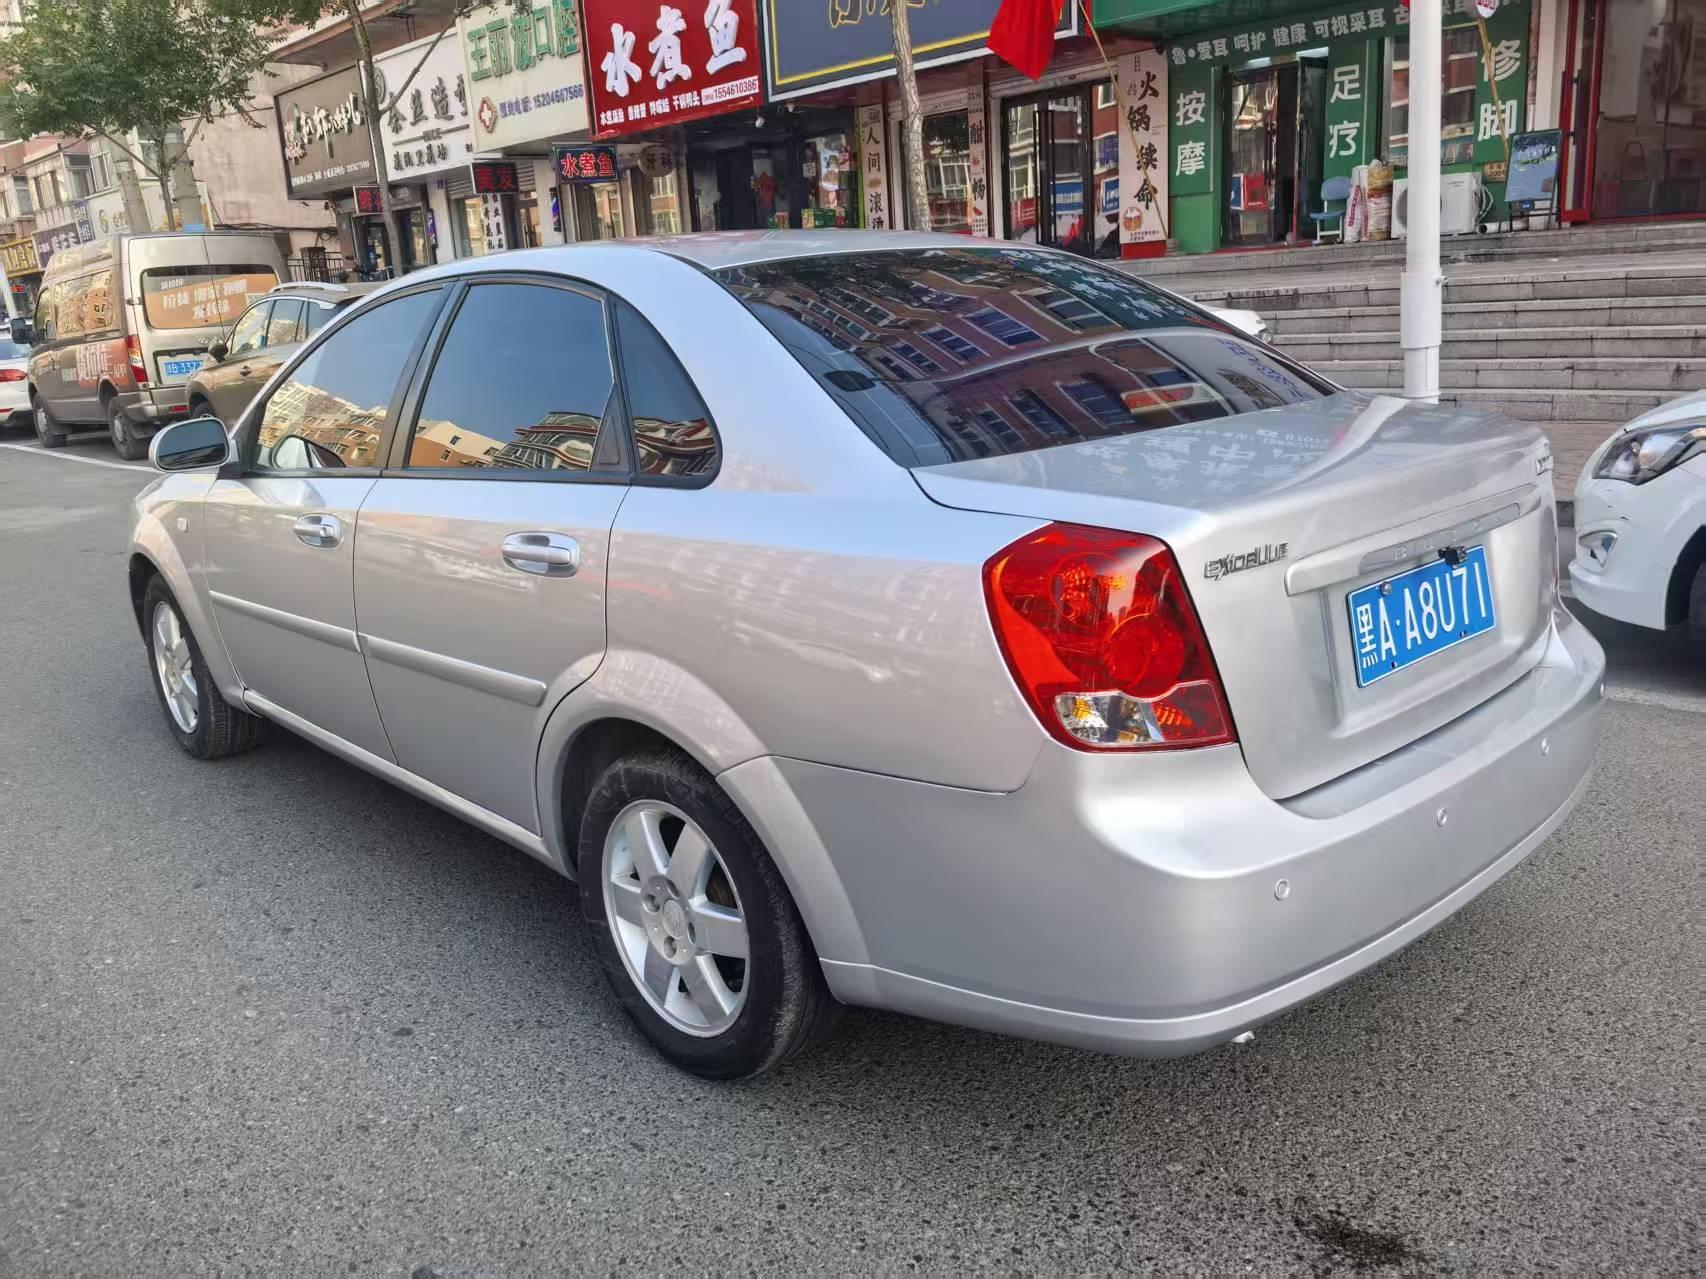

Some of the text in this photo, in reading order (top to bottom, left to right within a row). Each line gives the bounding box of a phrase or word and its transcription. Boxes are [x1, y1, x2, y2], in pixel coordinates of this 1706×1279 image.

[601, 0, 748, 98] 水煮鱼
[1233, 31, 1267, 53] 呵护
[1272, 23, 1307, 47] 健康
[1312, 8, 1386, 39] 可视采耳
[1175, 90, 1206, 177] 按摩
[1329, 64, 1361, 159] 足疗
[1477, 39, 1519, 142] 修脚
[475, 164, 514, 190] 美发
[560, 151, 615, 178] 水煮鱼
[1127, 71, 1160, 211] 火锅续命
